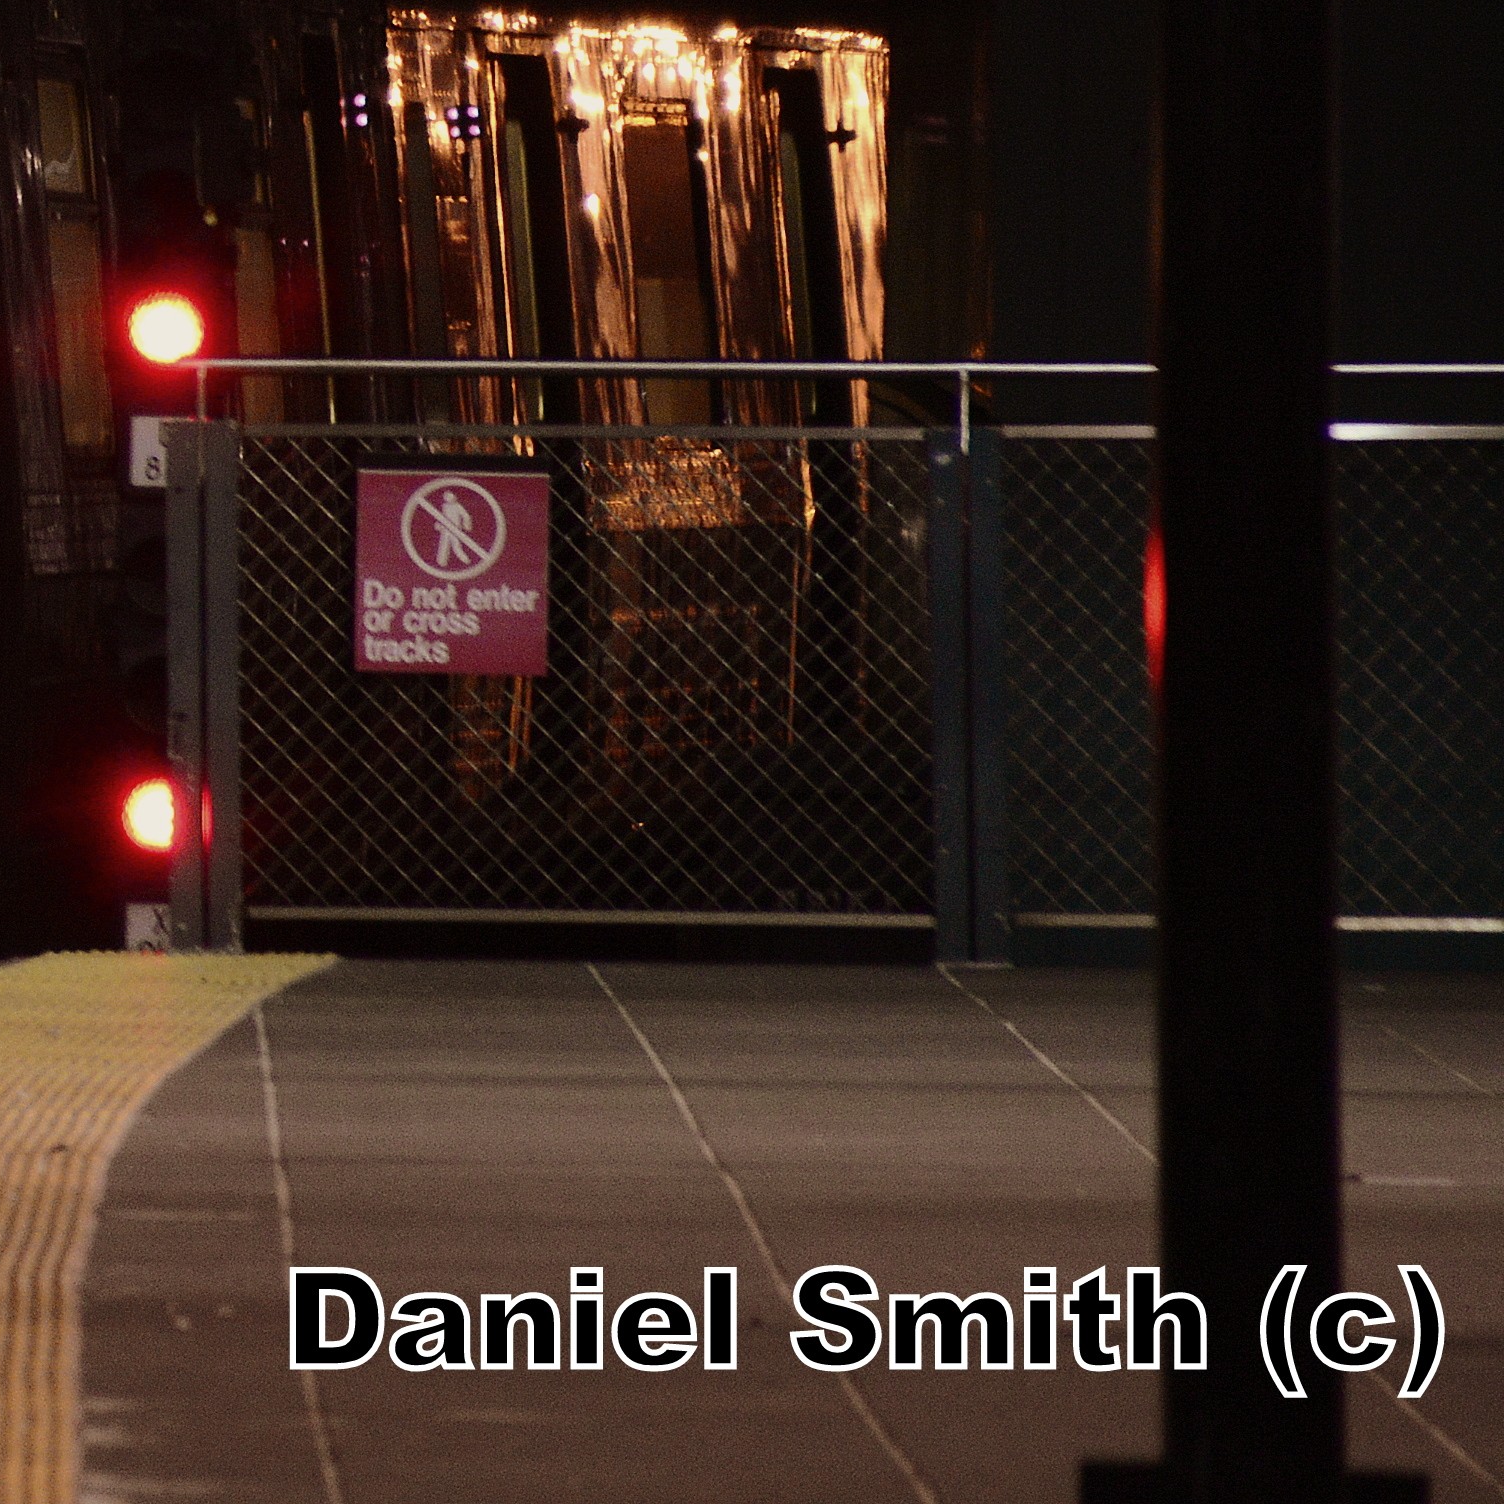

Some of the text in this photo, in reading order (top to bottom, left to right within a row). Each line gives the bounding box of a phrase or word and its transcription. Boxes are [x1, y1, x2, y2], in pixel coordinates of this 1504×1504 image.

[363, 579, 540, 613] Do not enter
[363, 610, 481, 636] or cross
[364, 633, 451, 664] tracks
